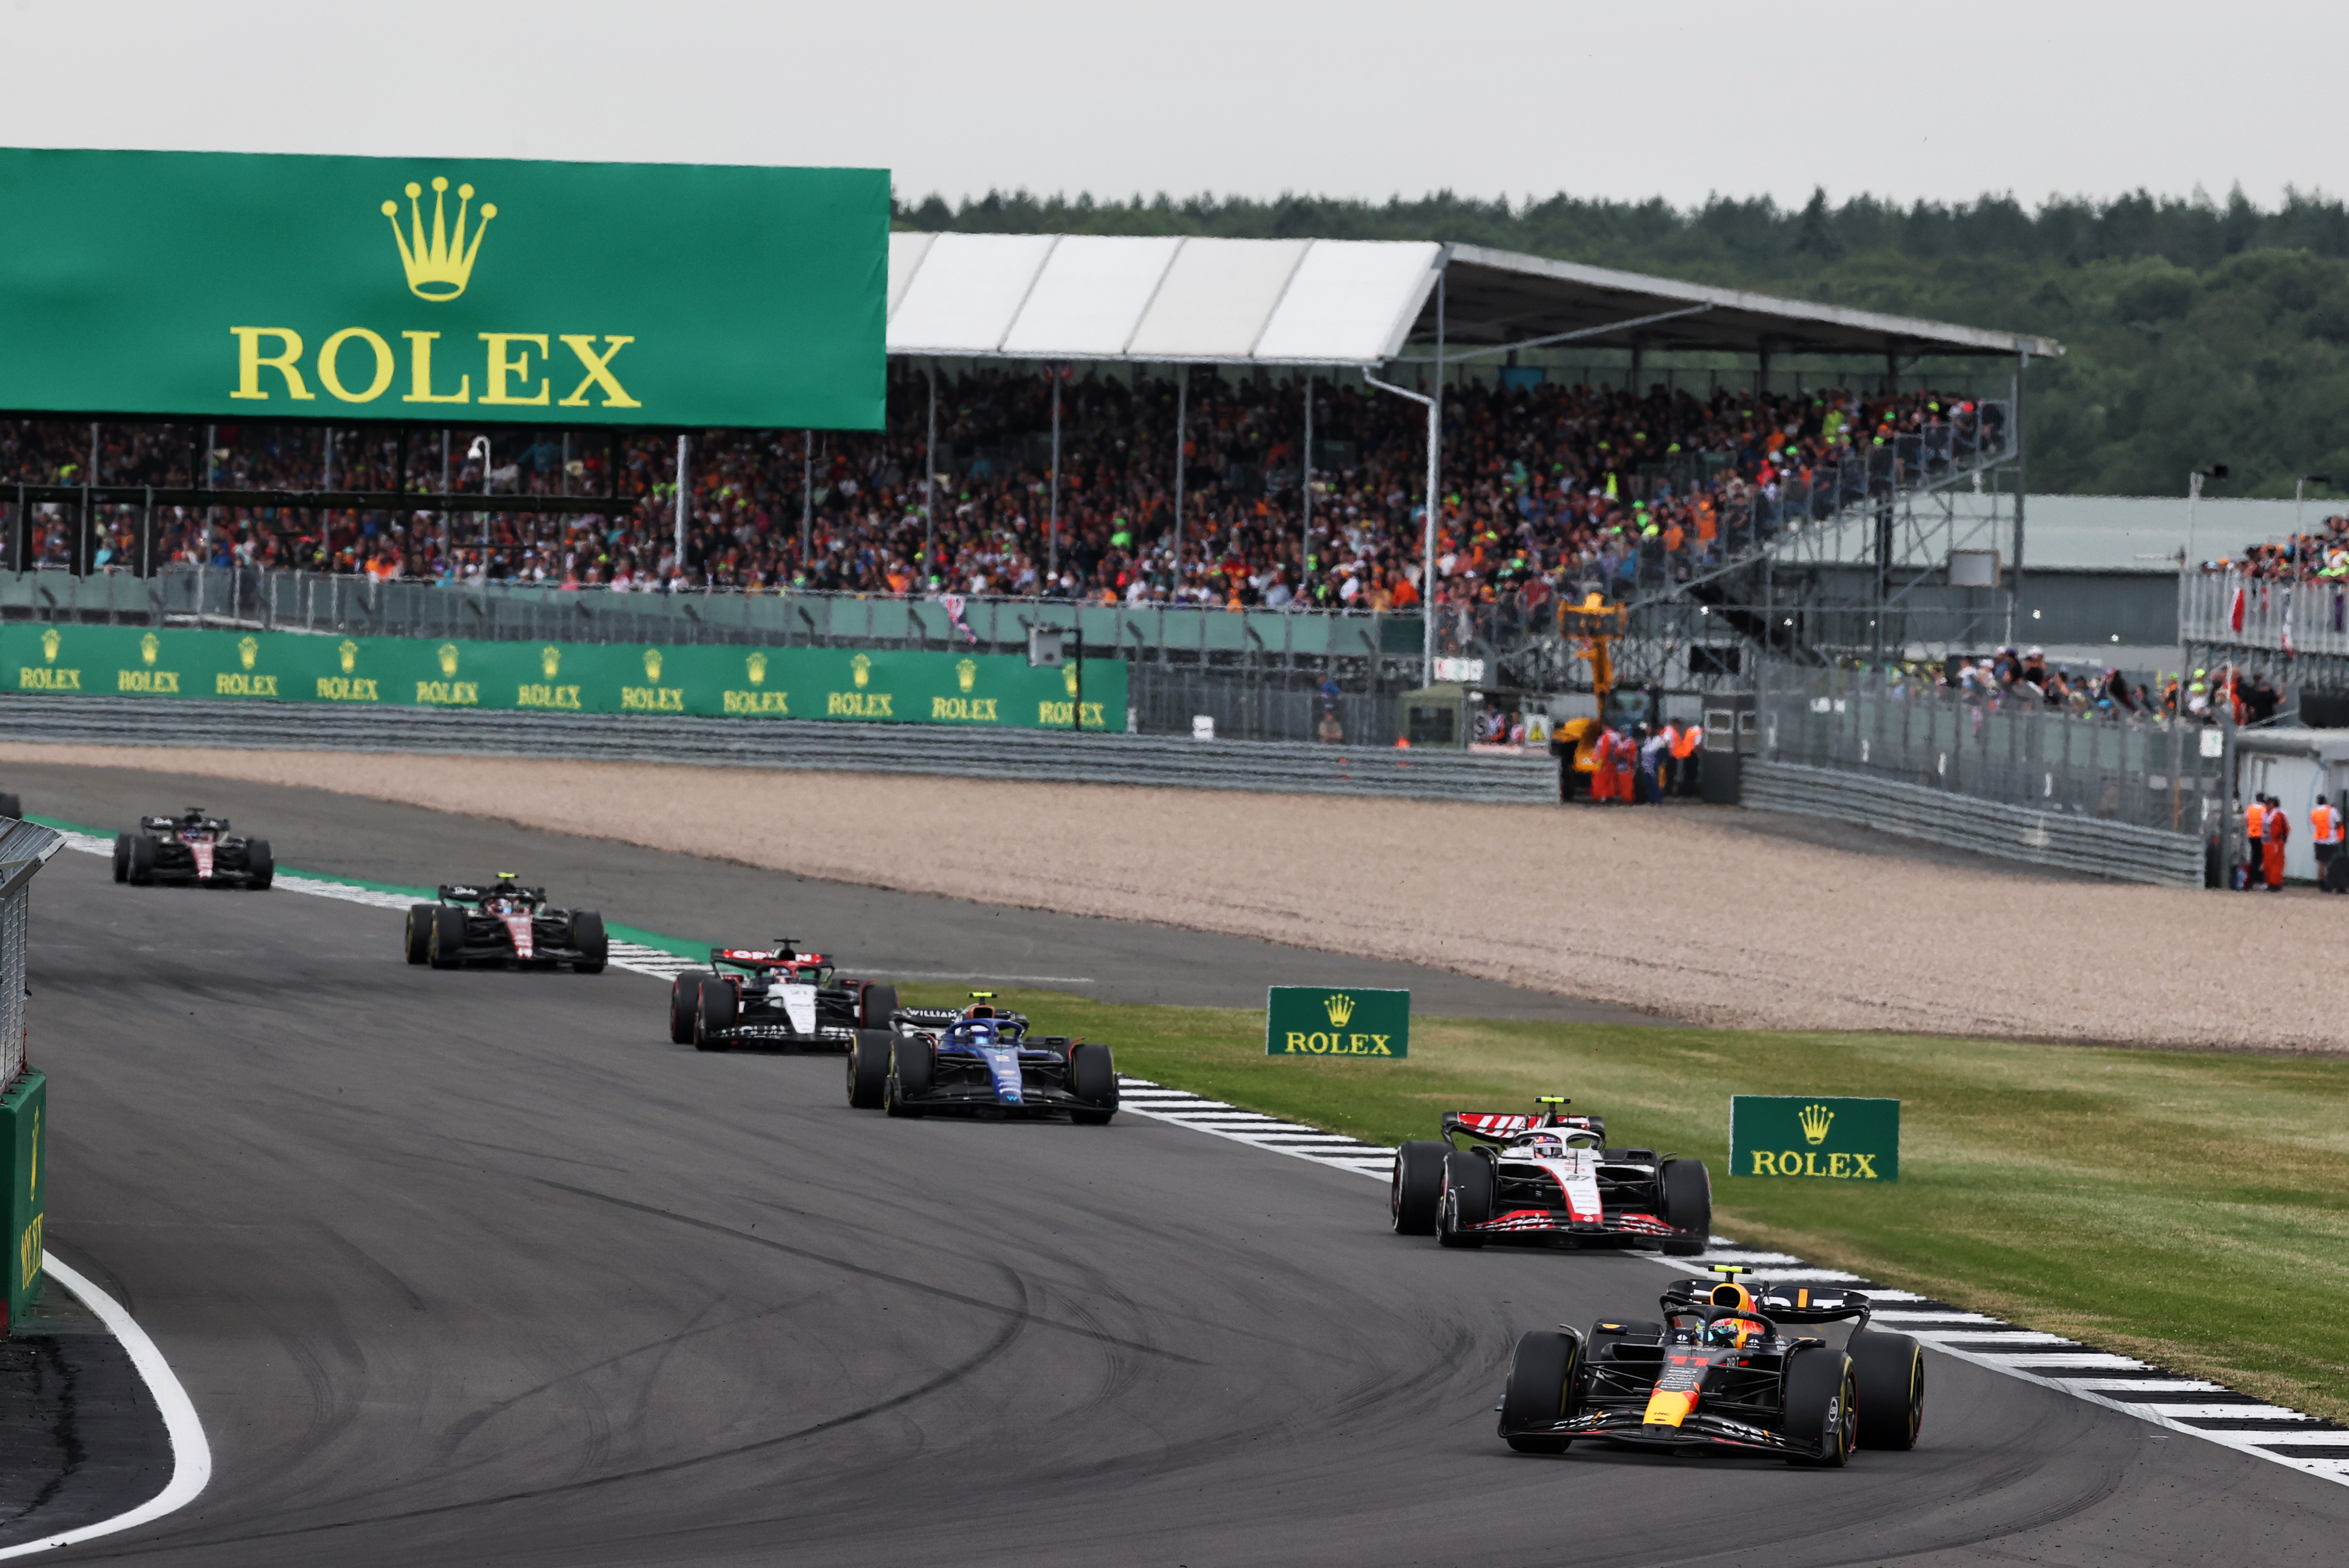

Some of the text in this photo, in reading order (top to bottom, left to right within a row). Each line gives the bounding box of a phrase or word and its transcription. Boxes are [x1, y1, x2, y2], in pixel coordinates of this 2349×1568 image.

[230, 326, 642, 408] ROLEX
[20, 667, 81, 690] ROLEX
[118, 671, 179, 692] ROLEX
[216, 673, 277, 695] ROLEX
[317, 677, 379, 701] ROLEX
[417, 681, 478, 704] ROLEX
[517, 684, 582, 709] ROLEX
[622, 687, 684, 711] ROLEX
[723, 691, 789, 713] ROLEX
[828, 692, 893, 716] ROLEX
[932, 697, 997, 720] ROLEX
[908, 1009, 957, 1018] WILLIAM
[1284, 1032, 1392, 1056] ROLEX
[1751, 1150, 1878, 1179] ROLEX
[1667, 1356, 1710, 1366] 11
